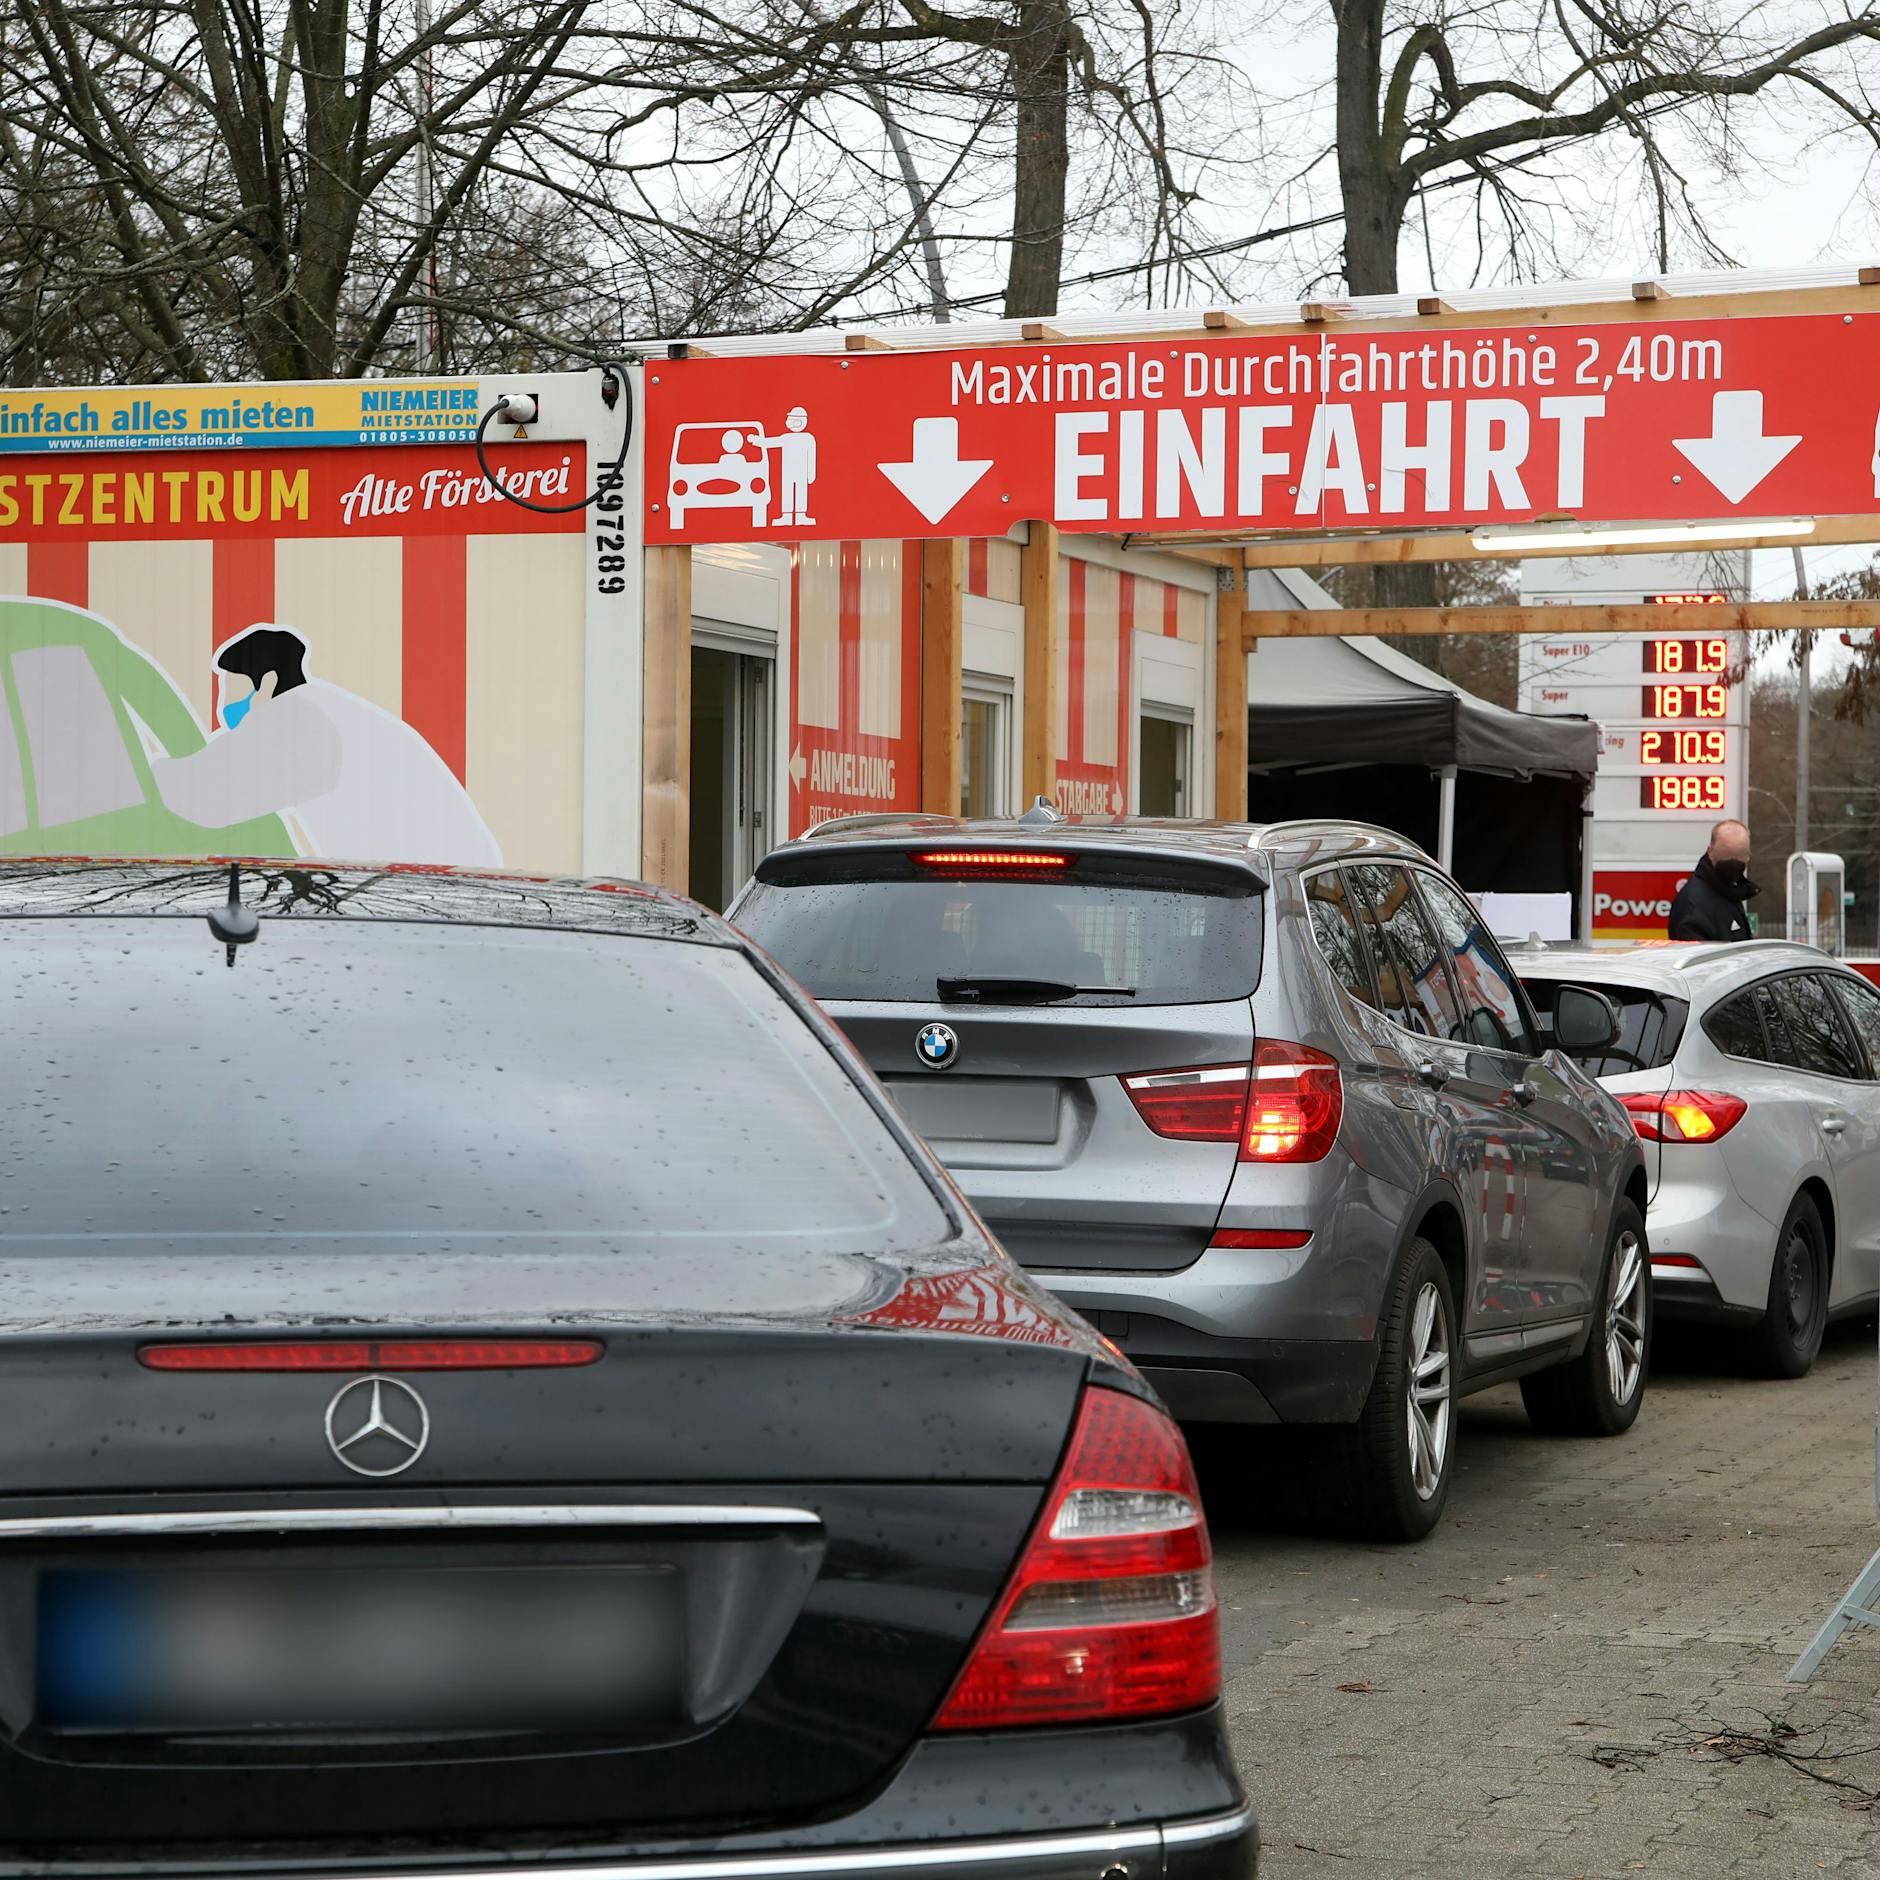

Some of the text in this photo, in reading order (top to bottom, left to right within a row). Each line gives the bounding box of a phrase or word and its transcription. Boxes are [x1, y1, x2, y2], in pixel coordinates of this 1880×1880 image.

[951, 334, 1722, 405] Maximale Durchfahrthöhe 2,40m
[111, 401, 187, 431] alles
[201, 399, 315, 429] mieten
[361, 389, 478, 411] NIEMEIER
[360, 430, 477, 442] 01805-308050
[361, 414, 477, 427] MIETSTATION
[48, 433, 243, 450] www.niemeier-mietstation.de
[1054, 395, 1605, 521] EINFAHRT
[0, 468, 309, 527] STZENTRUM
[340, 456, 571, 525] Alte Försterei
[1543, 644, 1569, 659] Super
[1573, 644, 1590, 657] E10
[1542, 686, 1726, 717] Super 187.9
[810, 749, 896, 800] ANMELDUNG
[1653, 776, 1724, 808] 198.9
[921, 1027, 952, 1041] BMW
